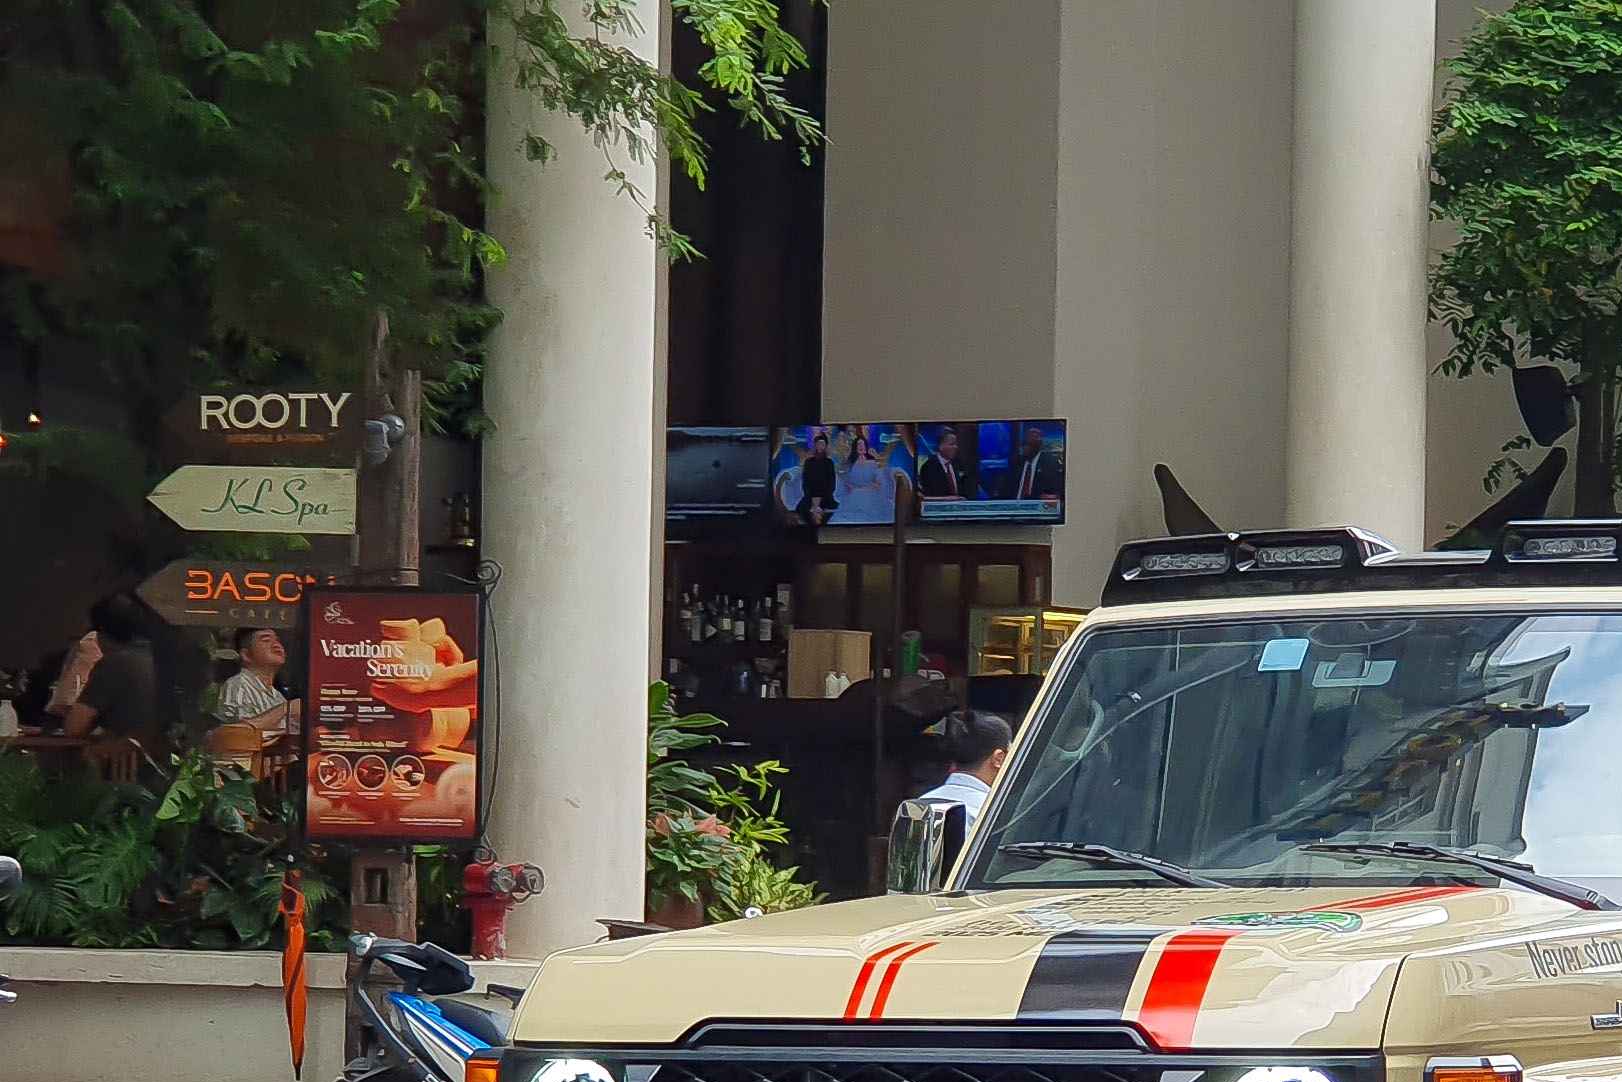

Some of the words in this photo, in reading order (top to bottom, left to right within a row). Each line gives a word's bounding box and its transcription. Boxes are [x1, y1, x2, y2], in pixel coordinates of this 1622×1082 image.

[201, 393, 352, 430] ROOTY
[201, 478, 273, 514] KL
[271, 478, 330, 525] Spa
[185, 570, 336, 602] BASO
[366, 659, 435, 682] Serenity
[1525, 940, 1583, 979] Never
